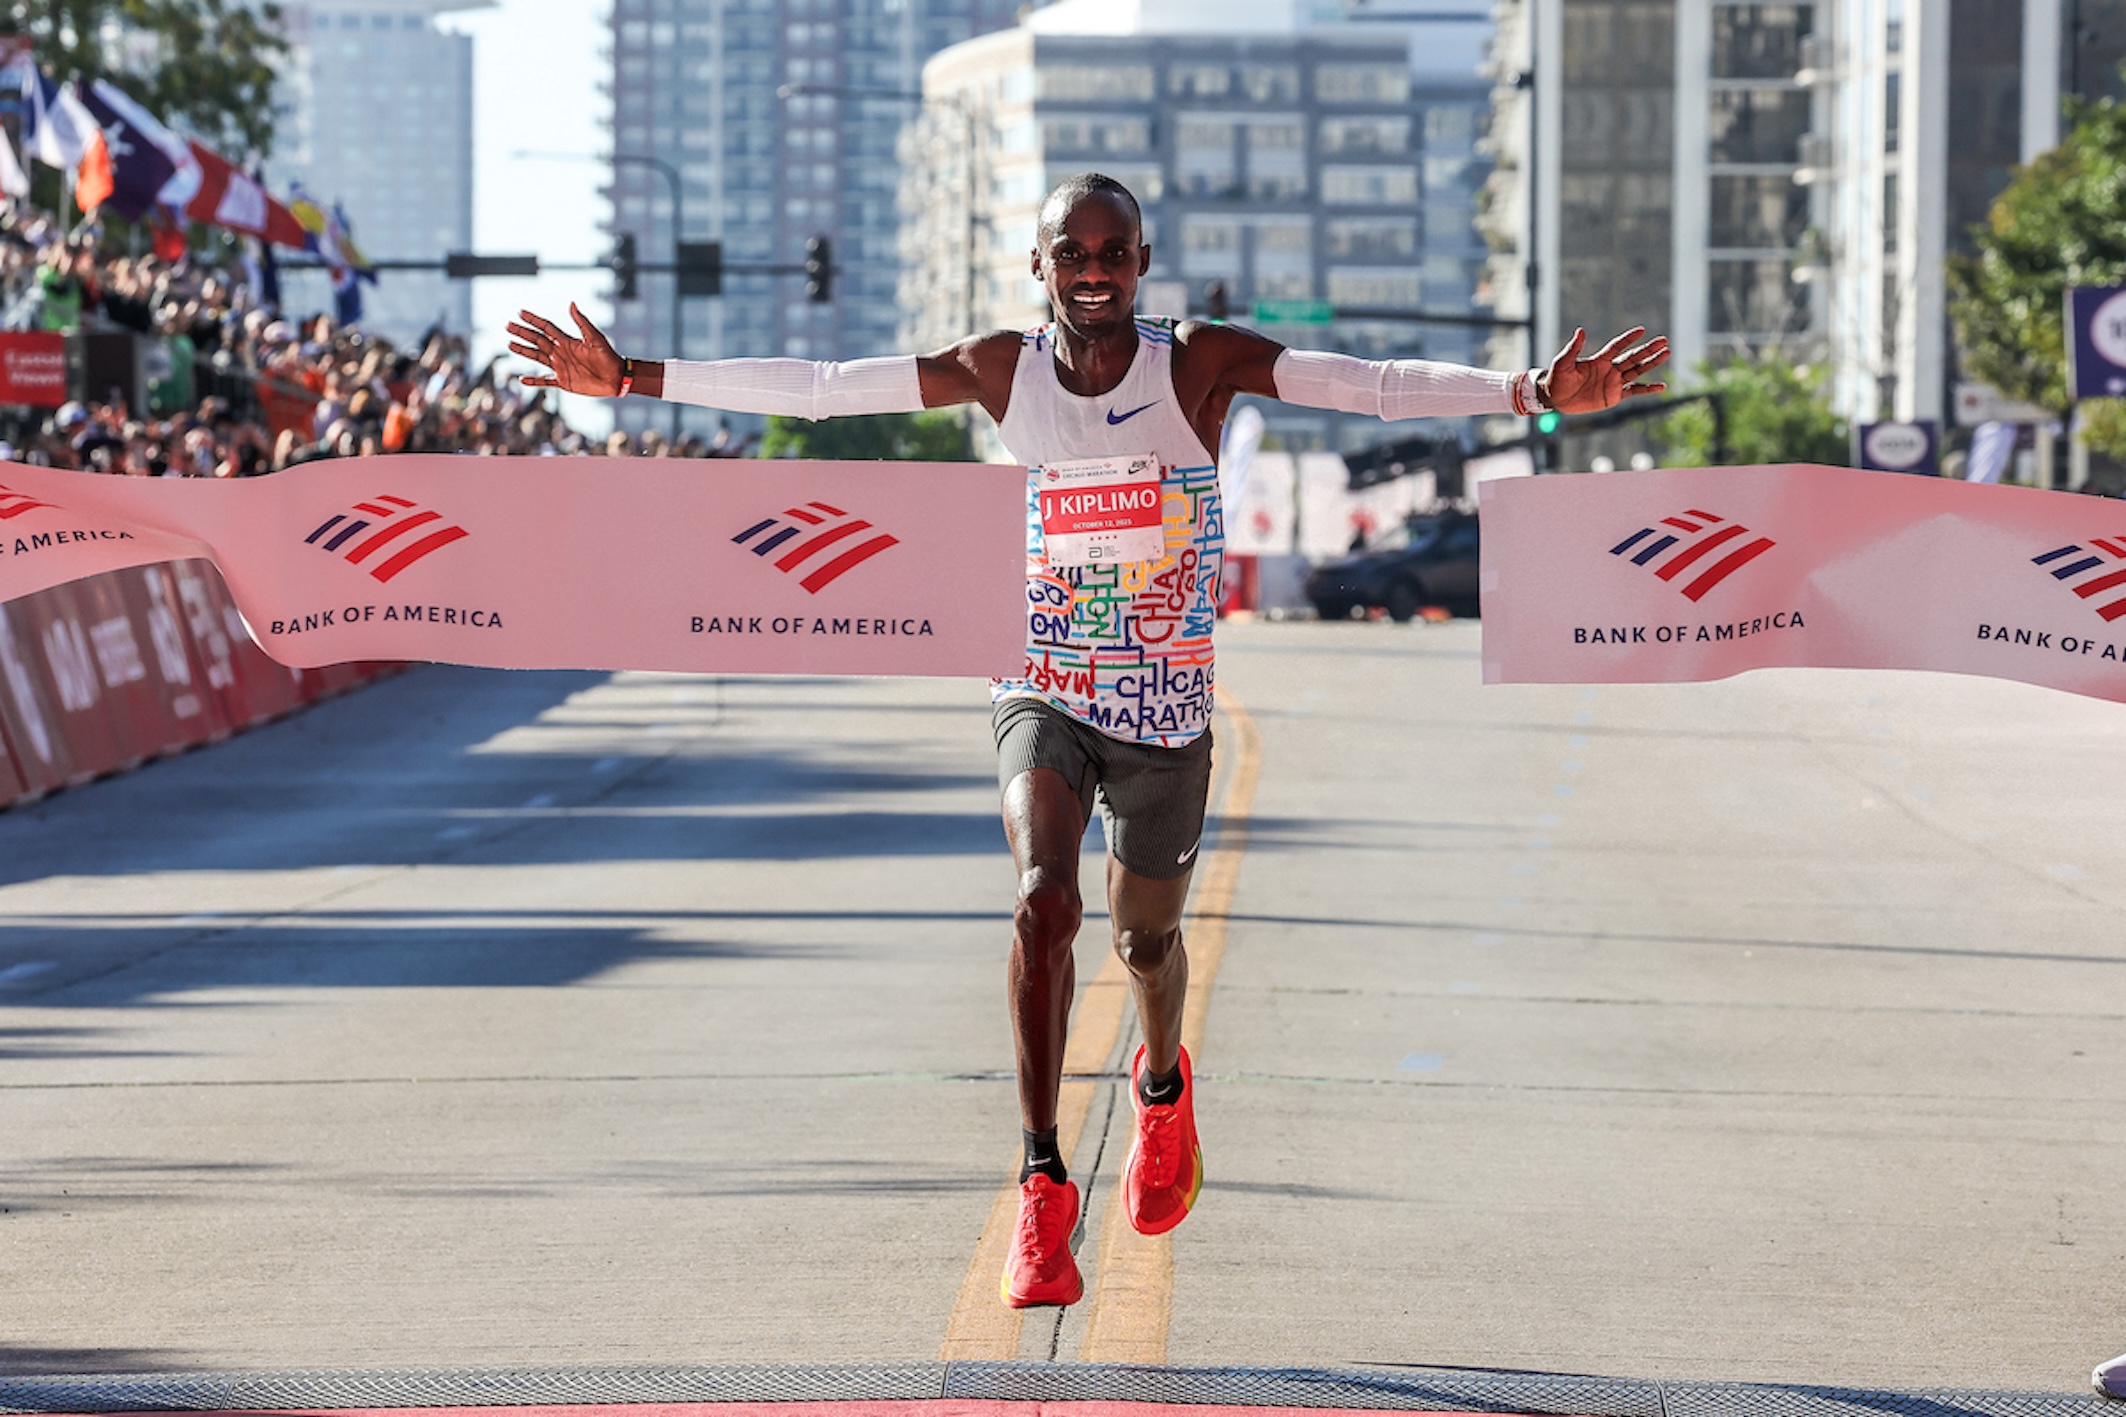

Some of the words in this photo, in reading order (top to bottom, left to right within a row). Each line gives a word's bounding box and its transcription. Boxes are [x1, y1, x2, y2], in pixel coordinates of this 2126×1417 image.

[1043, 496, 1053, 521] J
[1059, 488, 1157, 516] KIPLIMO
[14, 530, 135, 556] AMERICA
[270, 609, 336, 635] BANK
[343, 605, 377, 623] OF
[383, 605, 504, 629] AMERICA
[691, 616, 763, 634] BANK
[771, 616, 805, 634] OF
[811, 618, 934, 636] AMERICA
[1574, 627, 1647, 644] BANK
[1655, 626, 1688, 643] OF
[1695, 611, 1805, 642] AMERICA
[1977, 623, 2052, 649] BANK
[2060, 636, 2095, 655] OF
